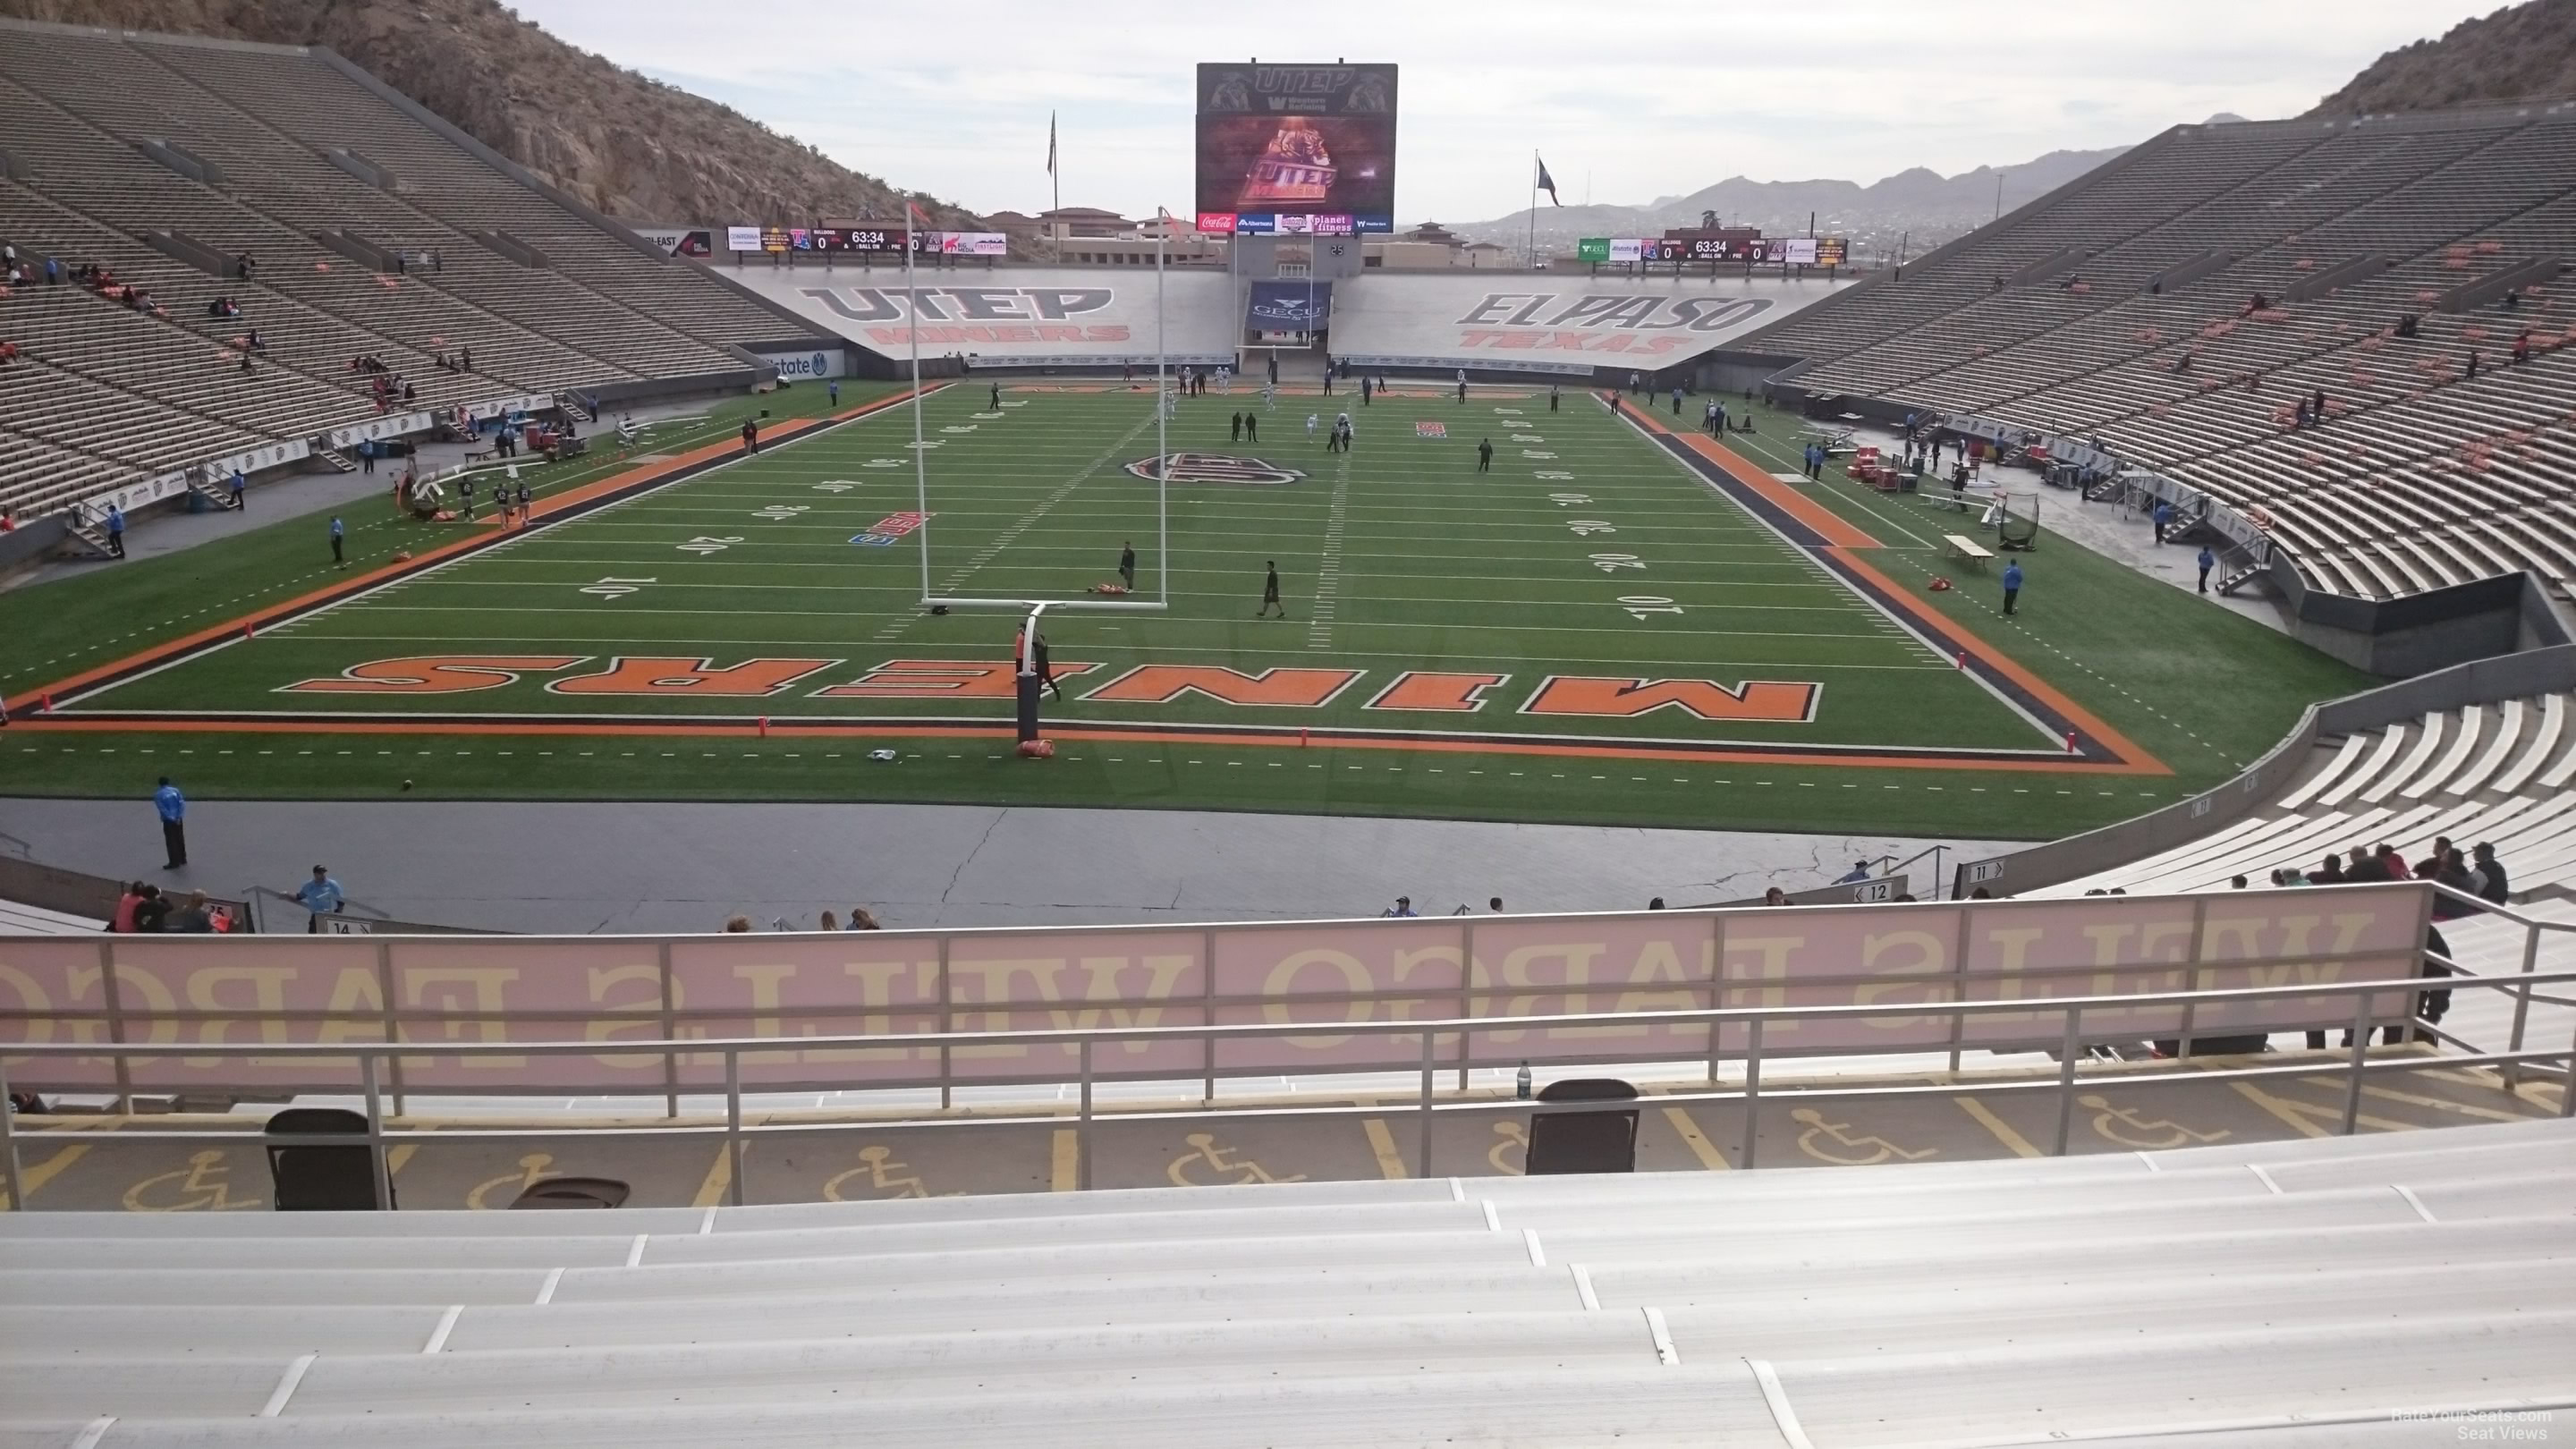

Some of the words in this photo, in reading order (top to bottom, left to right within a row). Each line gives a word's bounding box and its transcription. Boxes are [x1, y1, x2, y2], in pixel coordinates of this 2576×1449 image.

[1255, 67, 1356, 93] UTEP
[1314, 215, 1345, 225] planet
[1318, 224, 1352, 232] fitness
[818, 238, 826, 249] 0
[852, 232, 885, 243] 63:34
[1331, 245, 1343, 255] 25
[1664, 247, 1672, 258] 0
[1696, 241, 1727, 252] 63:34
[1753, 248, 1761, 259] 0
[795, 287, 1114, 322] UTEP
[1255, 305, 1320, 316] GECU
[1454, 293, 1558, 326] EL
[1542, 295, 1779, 332] PASO
[862, 325, 1131, 346] MINERS
[1459, 329, 1696, 355] TEXAS
[751, 505, 810, 517] 30
[1566, 521, 1616, 532] 30
[675, 537, 744, 551] 20
[1588, 554, 1647, 569] 20
[580, 577, 657, 594] 10
[1617, 596, 1684, 614] 10
[270, 656, 1825, 723] MINERS
[1977, 865, 1987, 880] 11
[1871, 886, 1886, 900] 12
[335, 923, 351, 935] 14
